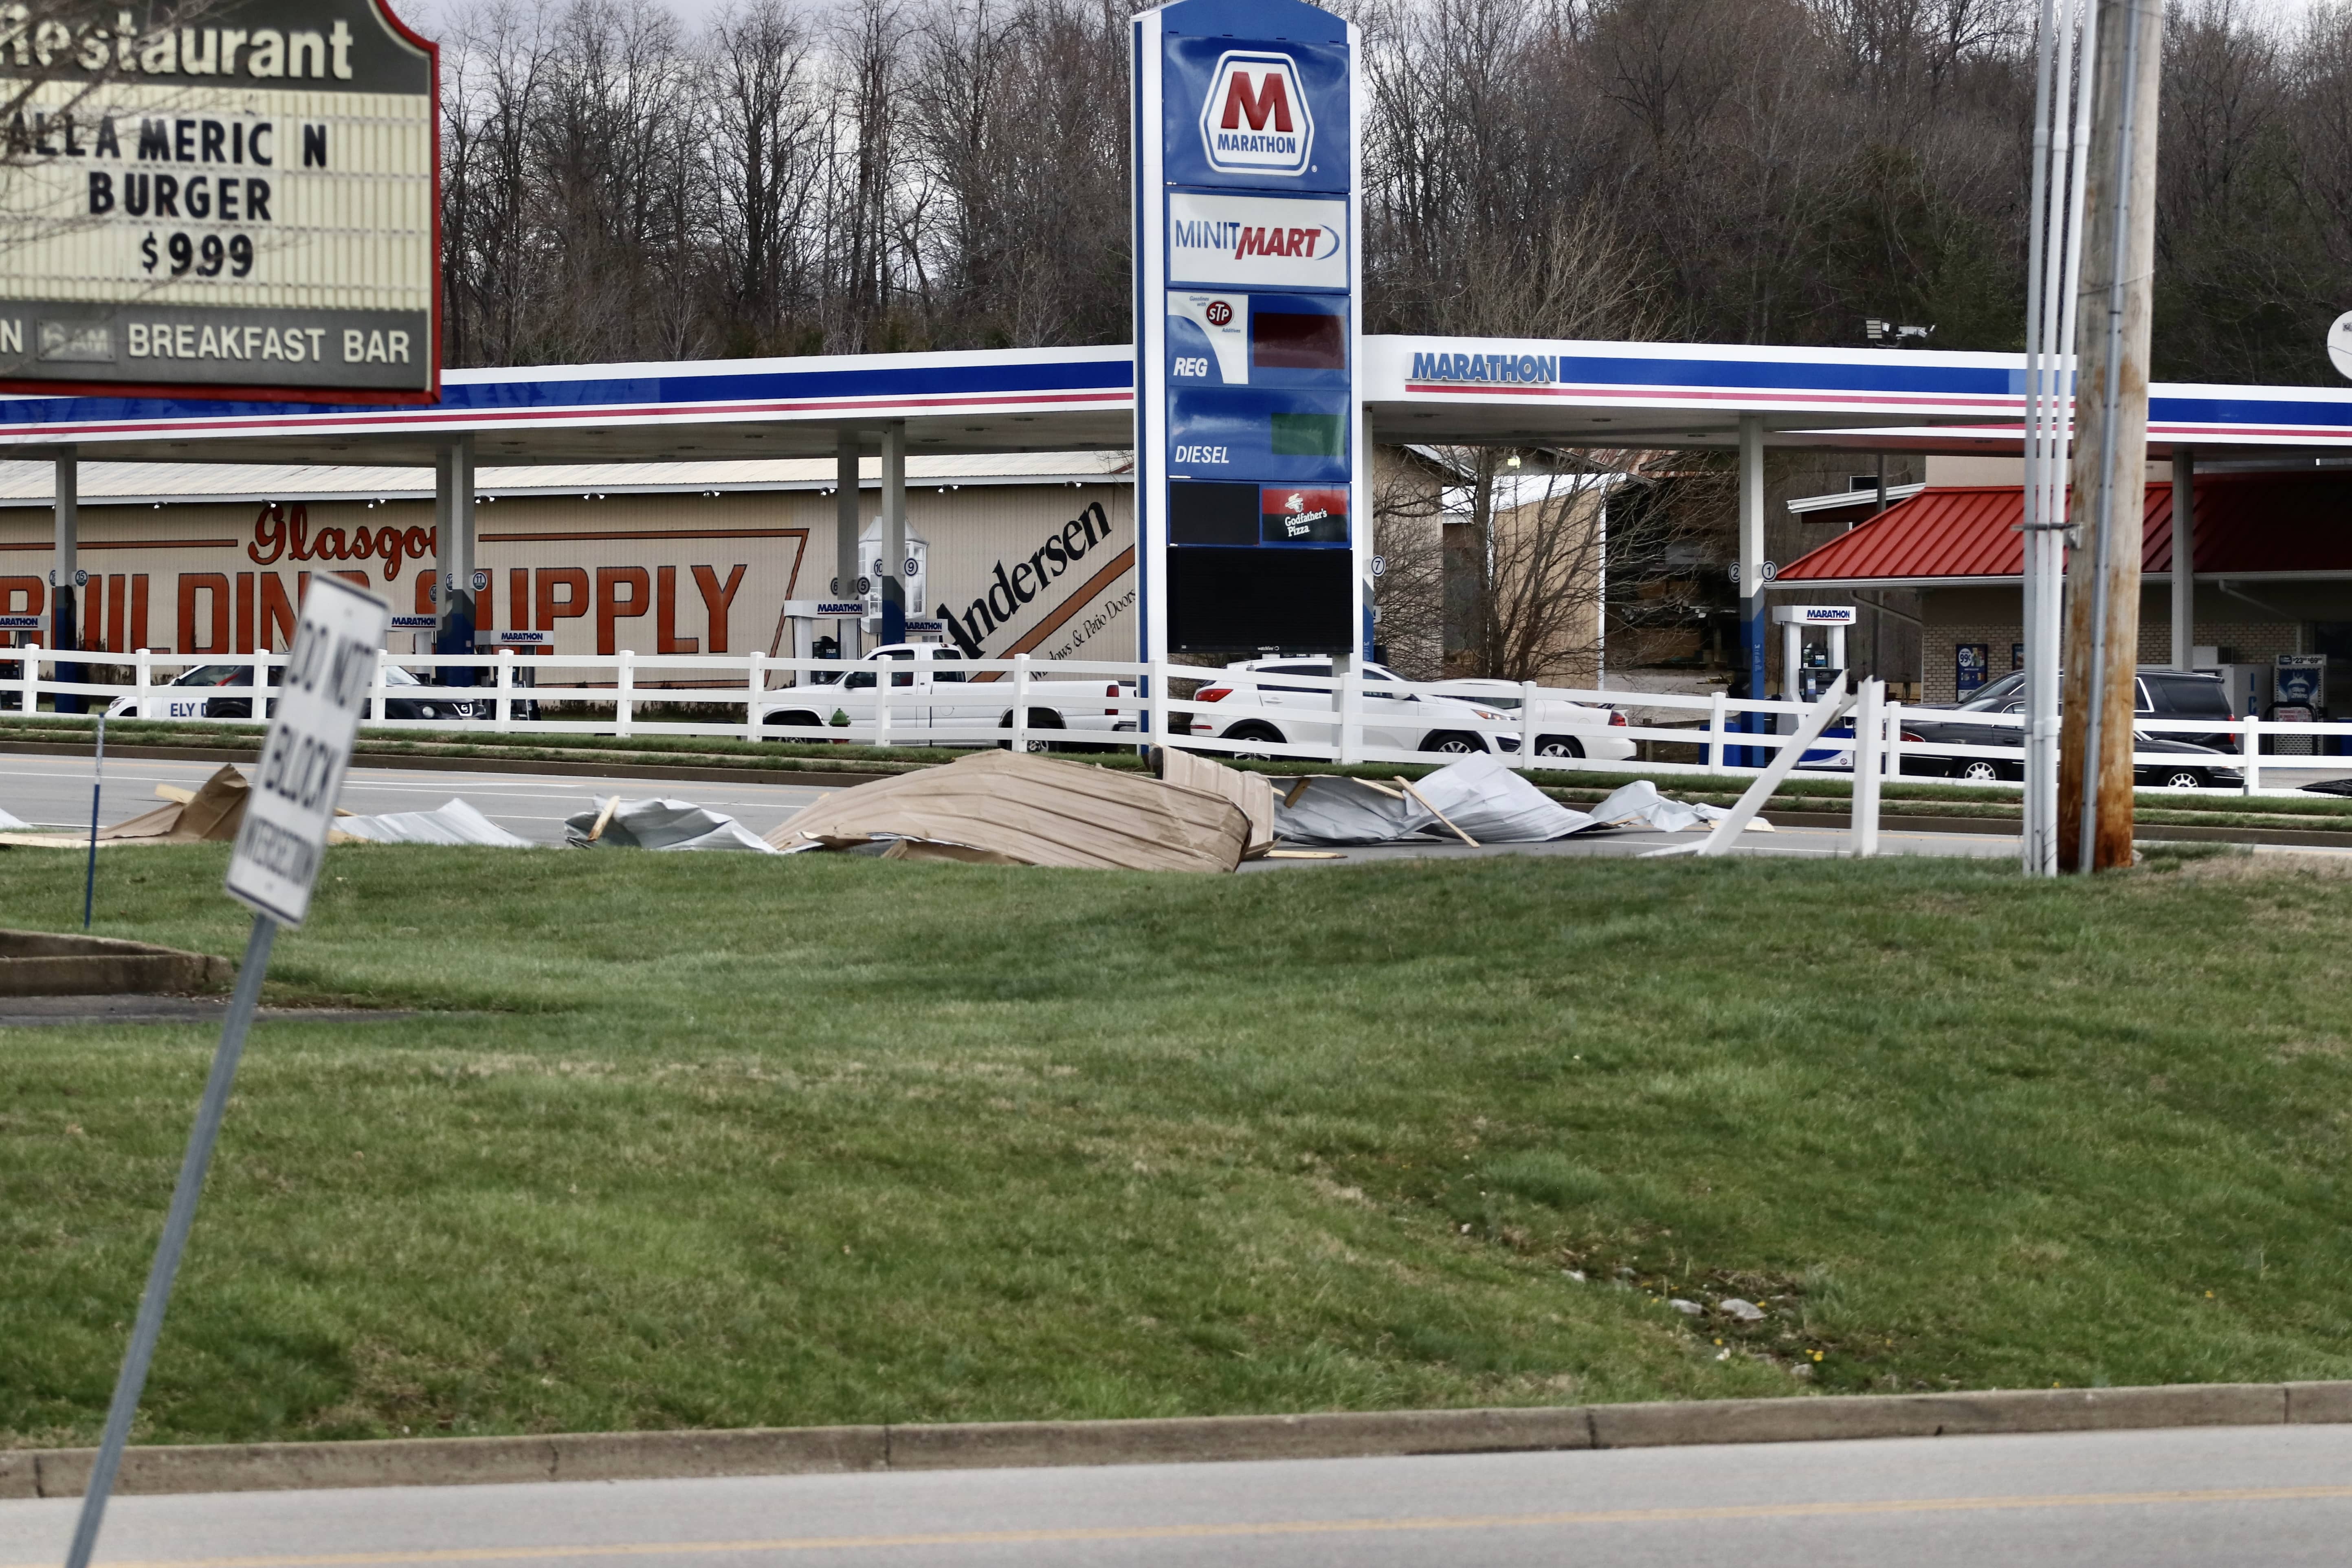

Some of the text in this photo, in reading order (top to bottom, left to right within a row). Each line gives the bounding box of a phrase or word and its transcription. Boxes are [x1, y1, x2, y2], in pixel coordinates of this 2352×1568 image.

[0, 2, 353, 80] Restaurant
[1217, 134, 1296, 154] MARATHON
[89, 172, 273, 221] BURGER
[1209, 303, 1229, 322] STP
[128, 324, 325, 362] BREAKFAST
[343, 330, 409, 364] BAR
[1173, 357, 1208, 377] REG
[1411, 352, 1557, 383] MARATHON
[1175, 445, 1230, 464] DIESEL
[1284, 508, 1328, 528] Godfather's
[1287, 525, 1310, 537] Pizza
[248, 502, 436, 581] Glasgo
[908, 562, 914, 572] 9
[1375, 561, 1380, 571] 7
[1733, 567, 1739, 577] 2
[860, 581, 866, 590] 5
[936, 501, 1112, 660] Andersen
[817, 603, 862, 612] MARATHON
[1083, 614, 1107, 639] Patio
[1104, 589, 1136, 620] Doors
[1807, 609, 1850, 619] MARATHON
[391, 617, 436, 625] MARATHON
[170, 703, 196, 717] ELY
